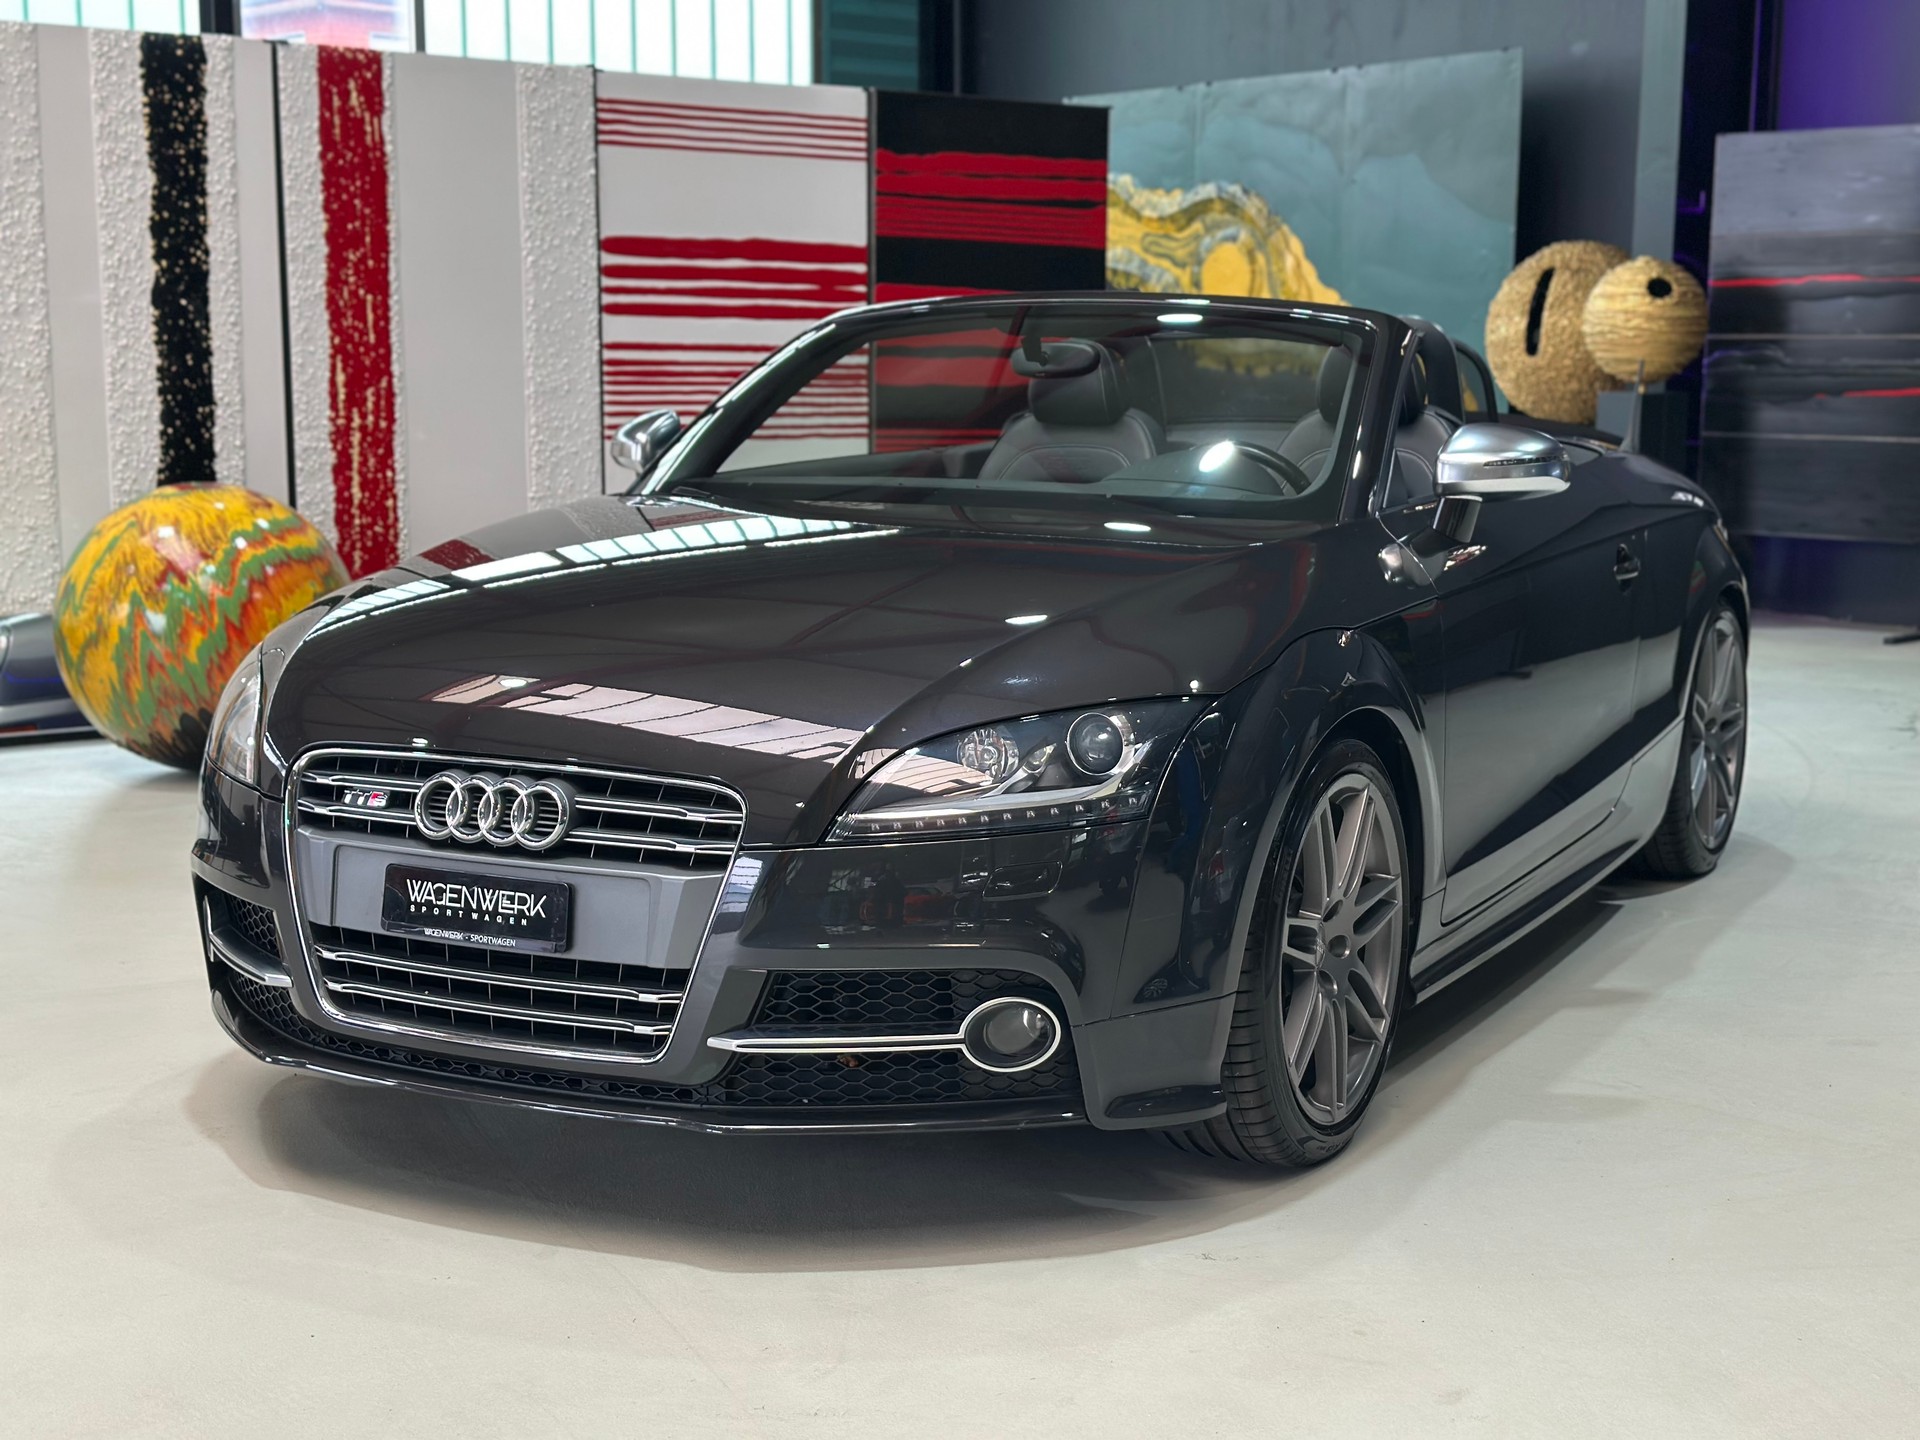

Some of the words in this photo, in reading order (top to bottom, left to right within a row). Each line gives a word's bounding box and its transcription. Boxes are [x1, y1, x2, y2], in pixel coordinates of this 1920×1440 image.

[343, 789, 388, 807] TTS
[406, 878, 547, 918] WAGENWERK
[410, 904, 527, 926] SPORTWAGEN
[424, 927, 463, 940] WAGENWERK
[470, 933, 516, 947] SPORTWAGEN
